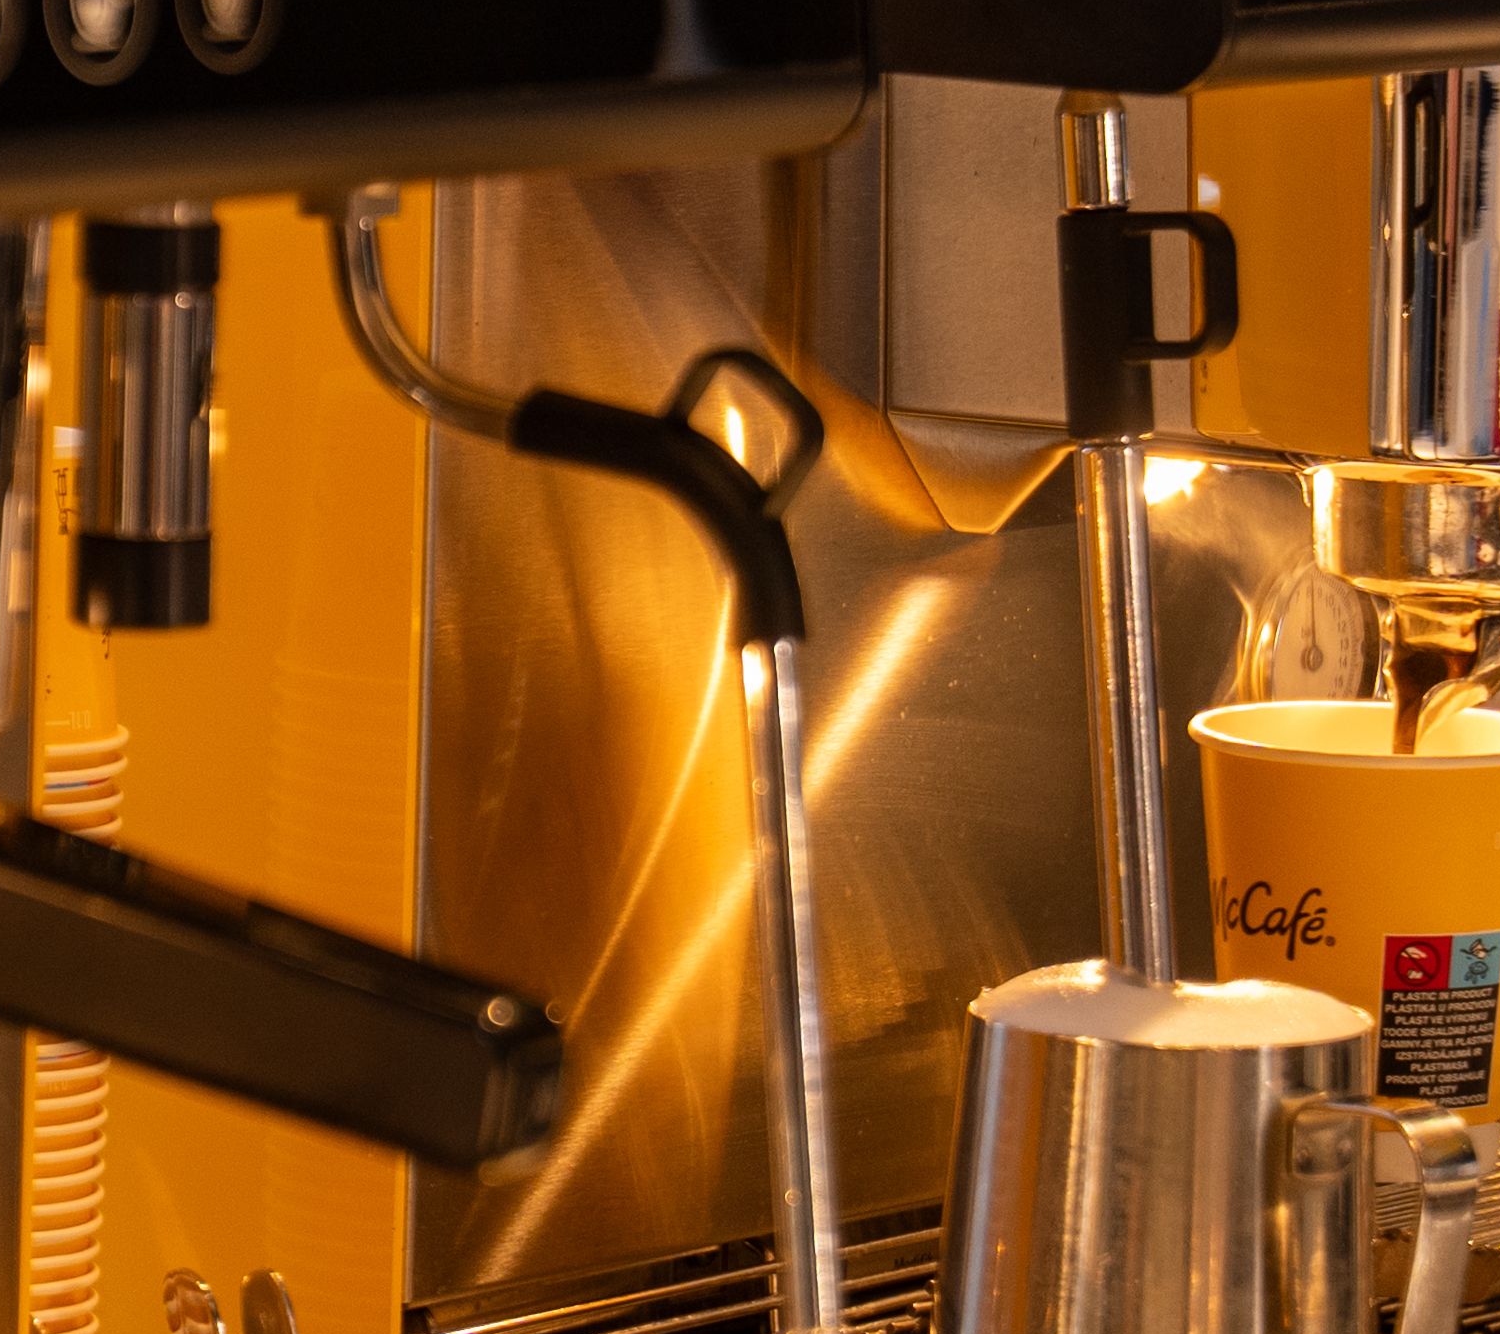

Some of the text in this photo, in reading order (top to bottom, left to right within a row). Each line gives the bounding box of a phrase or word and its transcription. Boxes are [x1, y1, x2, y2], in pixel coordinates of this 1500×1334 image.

[1392, 987, 1493, 1001] PLASTIC IN PRODUCT
[1384, 1004, 1436, 1013] PLASTIKA
[1394, 1015, 1429, 1025] PLAST
[1385, 1074, 1436, 1084] PRODUKT
[1419, 1085, 1458, 1095] PLASTY
